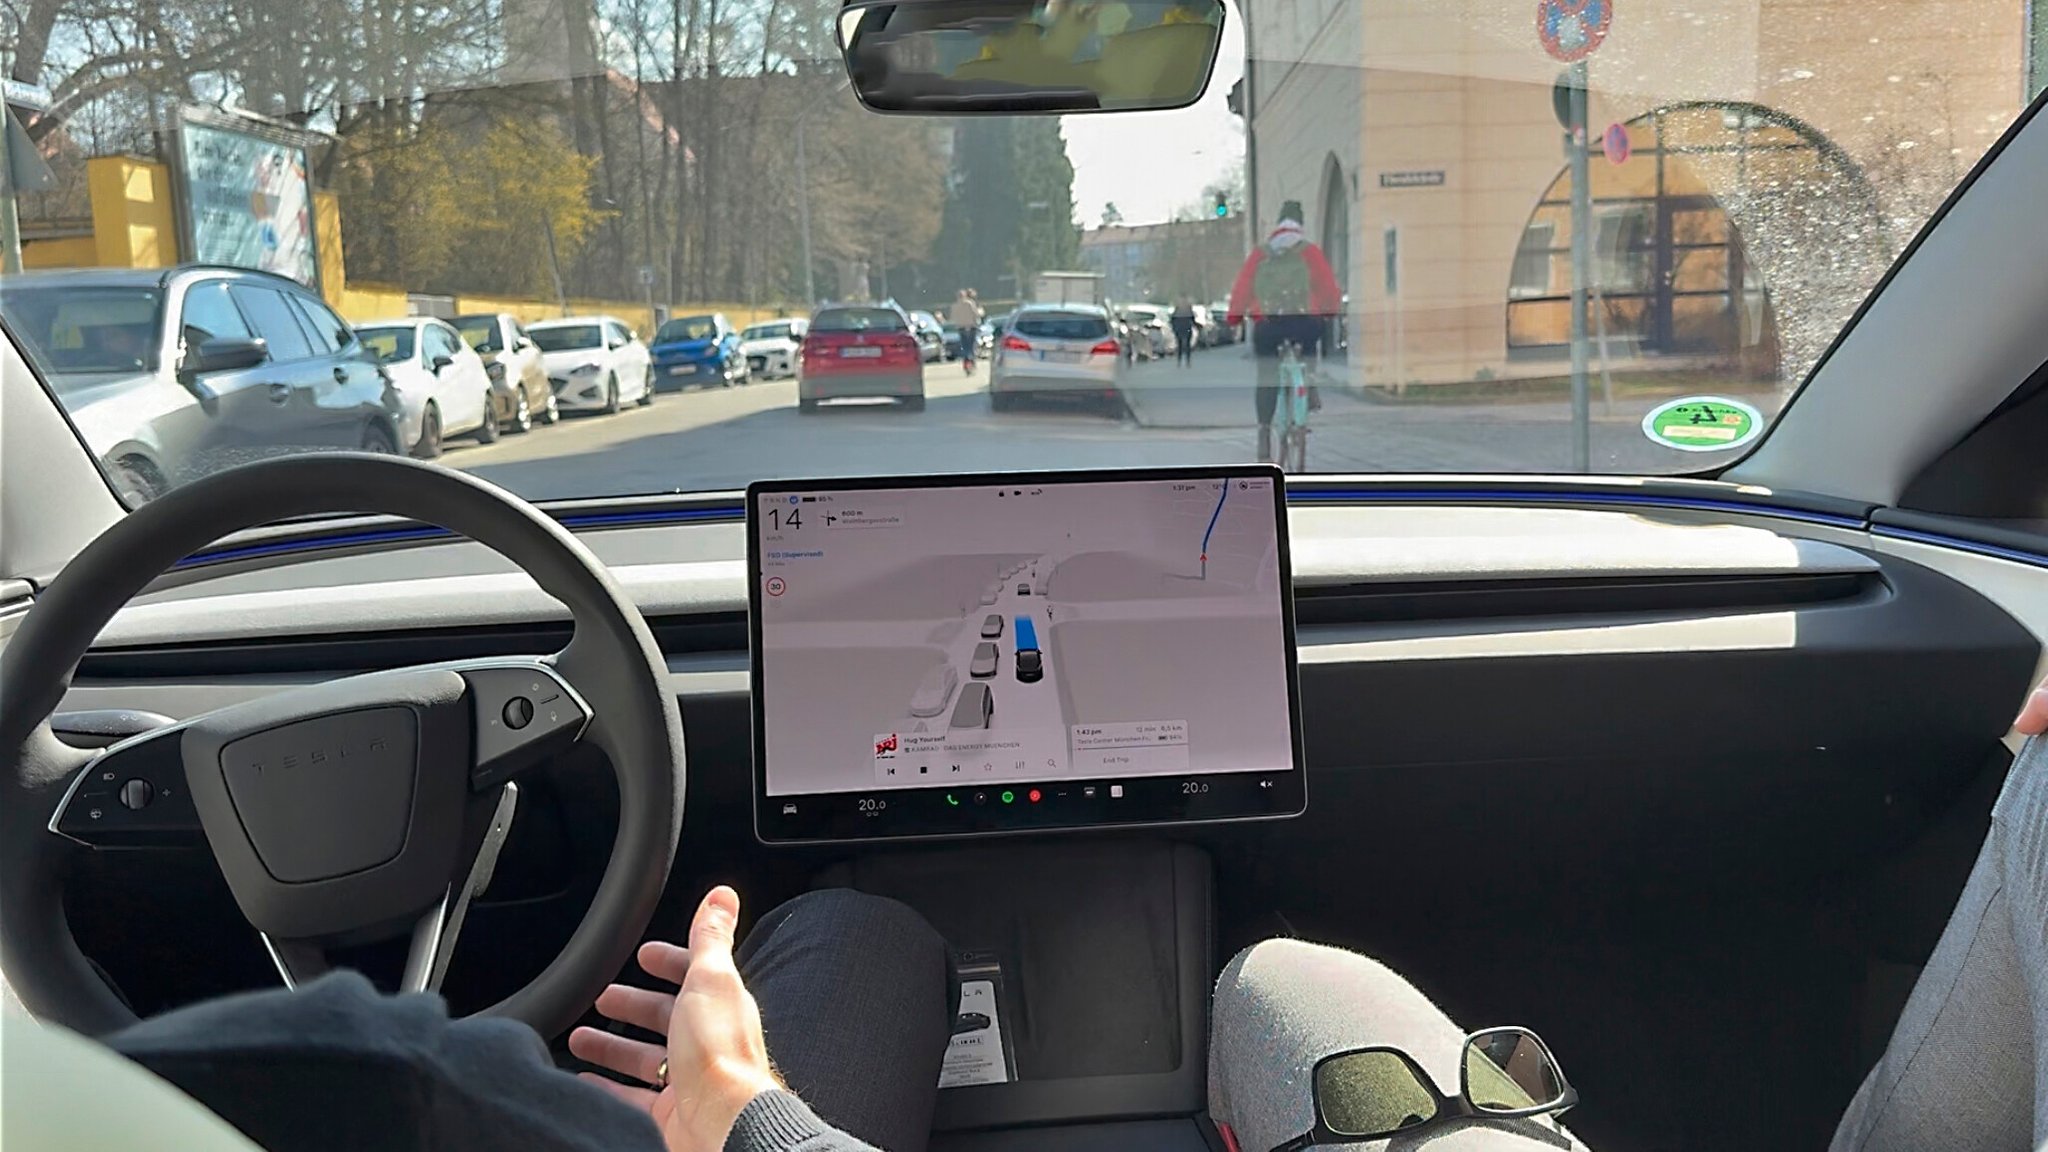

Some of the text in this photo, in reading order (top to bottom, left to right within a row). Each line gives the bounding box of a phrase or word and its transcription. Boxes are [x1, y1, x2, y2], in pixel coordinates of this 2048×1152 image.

[768, 508, 803, 531] 14
[770, 582, 781, 591] 30
[919, 735, 946, 743] Yourself
[251, 736, 387, 774] TESLA
[1116, 756, 1130, 764] Trip
[1182, 782, 1209, 794] 20.0
[858, 798, 887, 811] 20.0
